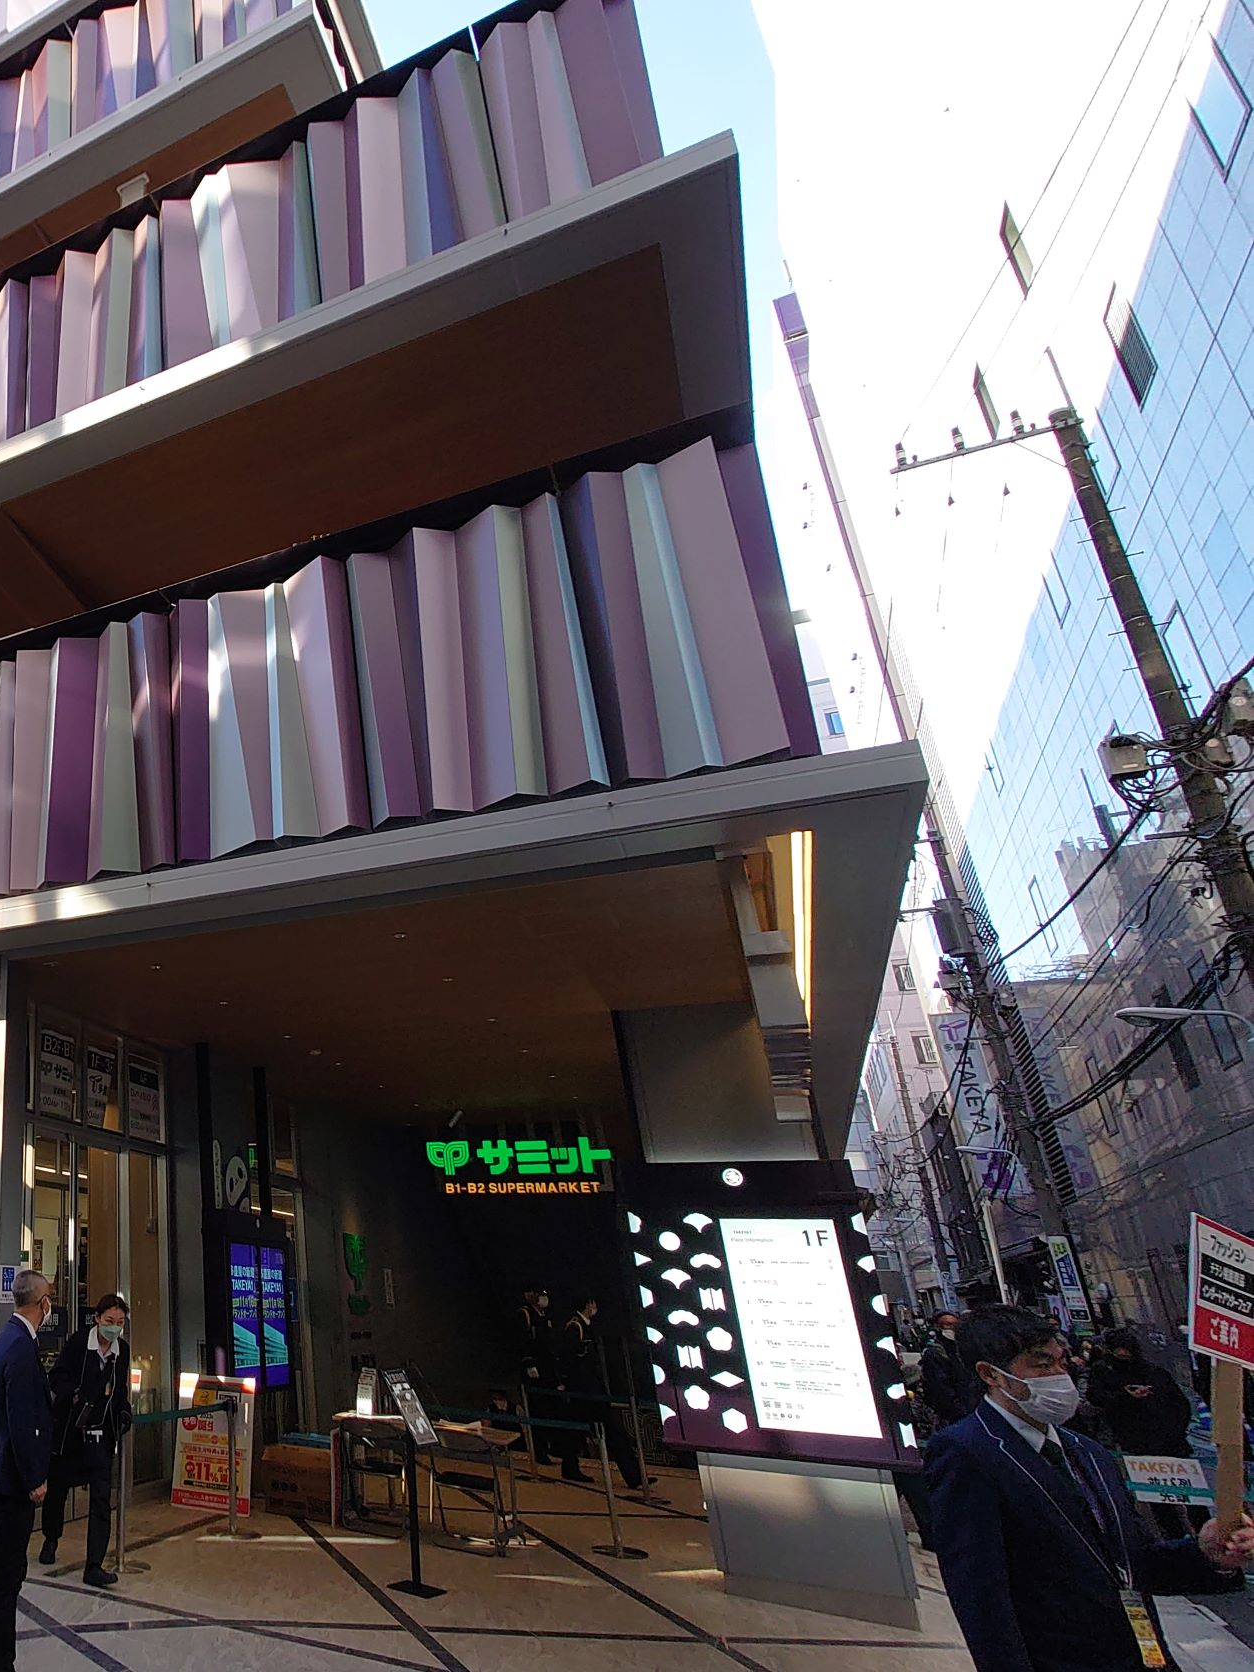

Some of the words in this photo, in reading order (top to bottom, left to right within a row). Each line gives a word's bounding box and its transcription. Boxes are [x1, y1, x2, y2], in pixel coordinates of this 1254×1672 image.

[955, 1057, 992, 1135] TAKEYA
[477, 1137, 612, 1175] サミット
[446, 1183, 486, 1194] B1-B2
[489, 1181, 600, 1194] SUPERMARKET
[802, 1230, 829, 1246] 1F
[1210, 1317, 1239, 1349] ご案内
[1129, 1461, 1187, 1474] TAKEYA
